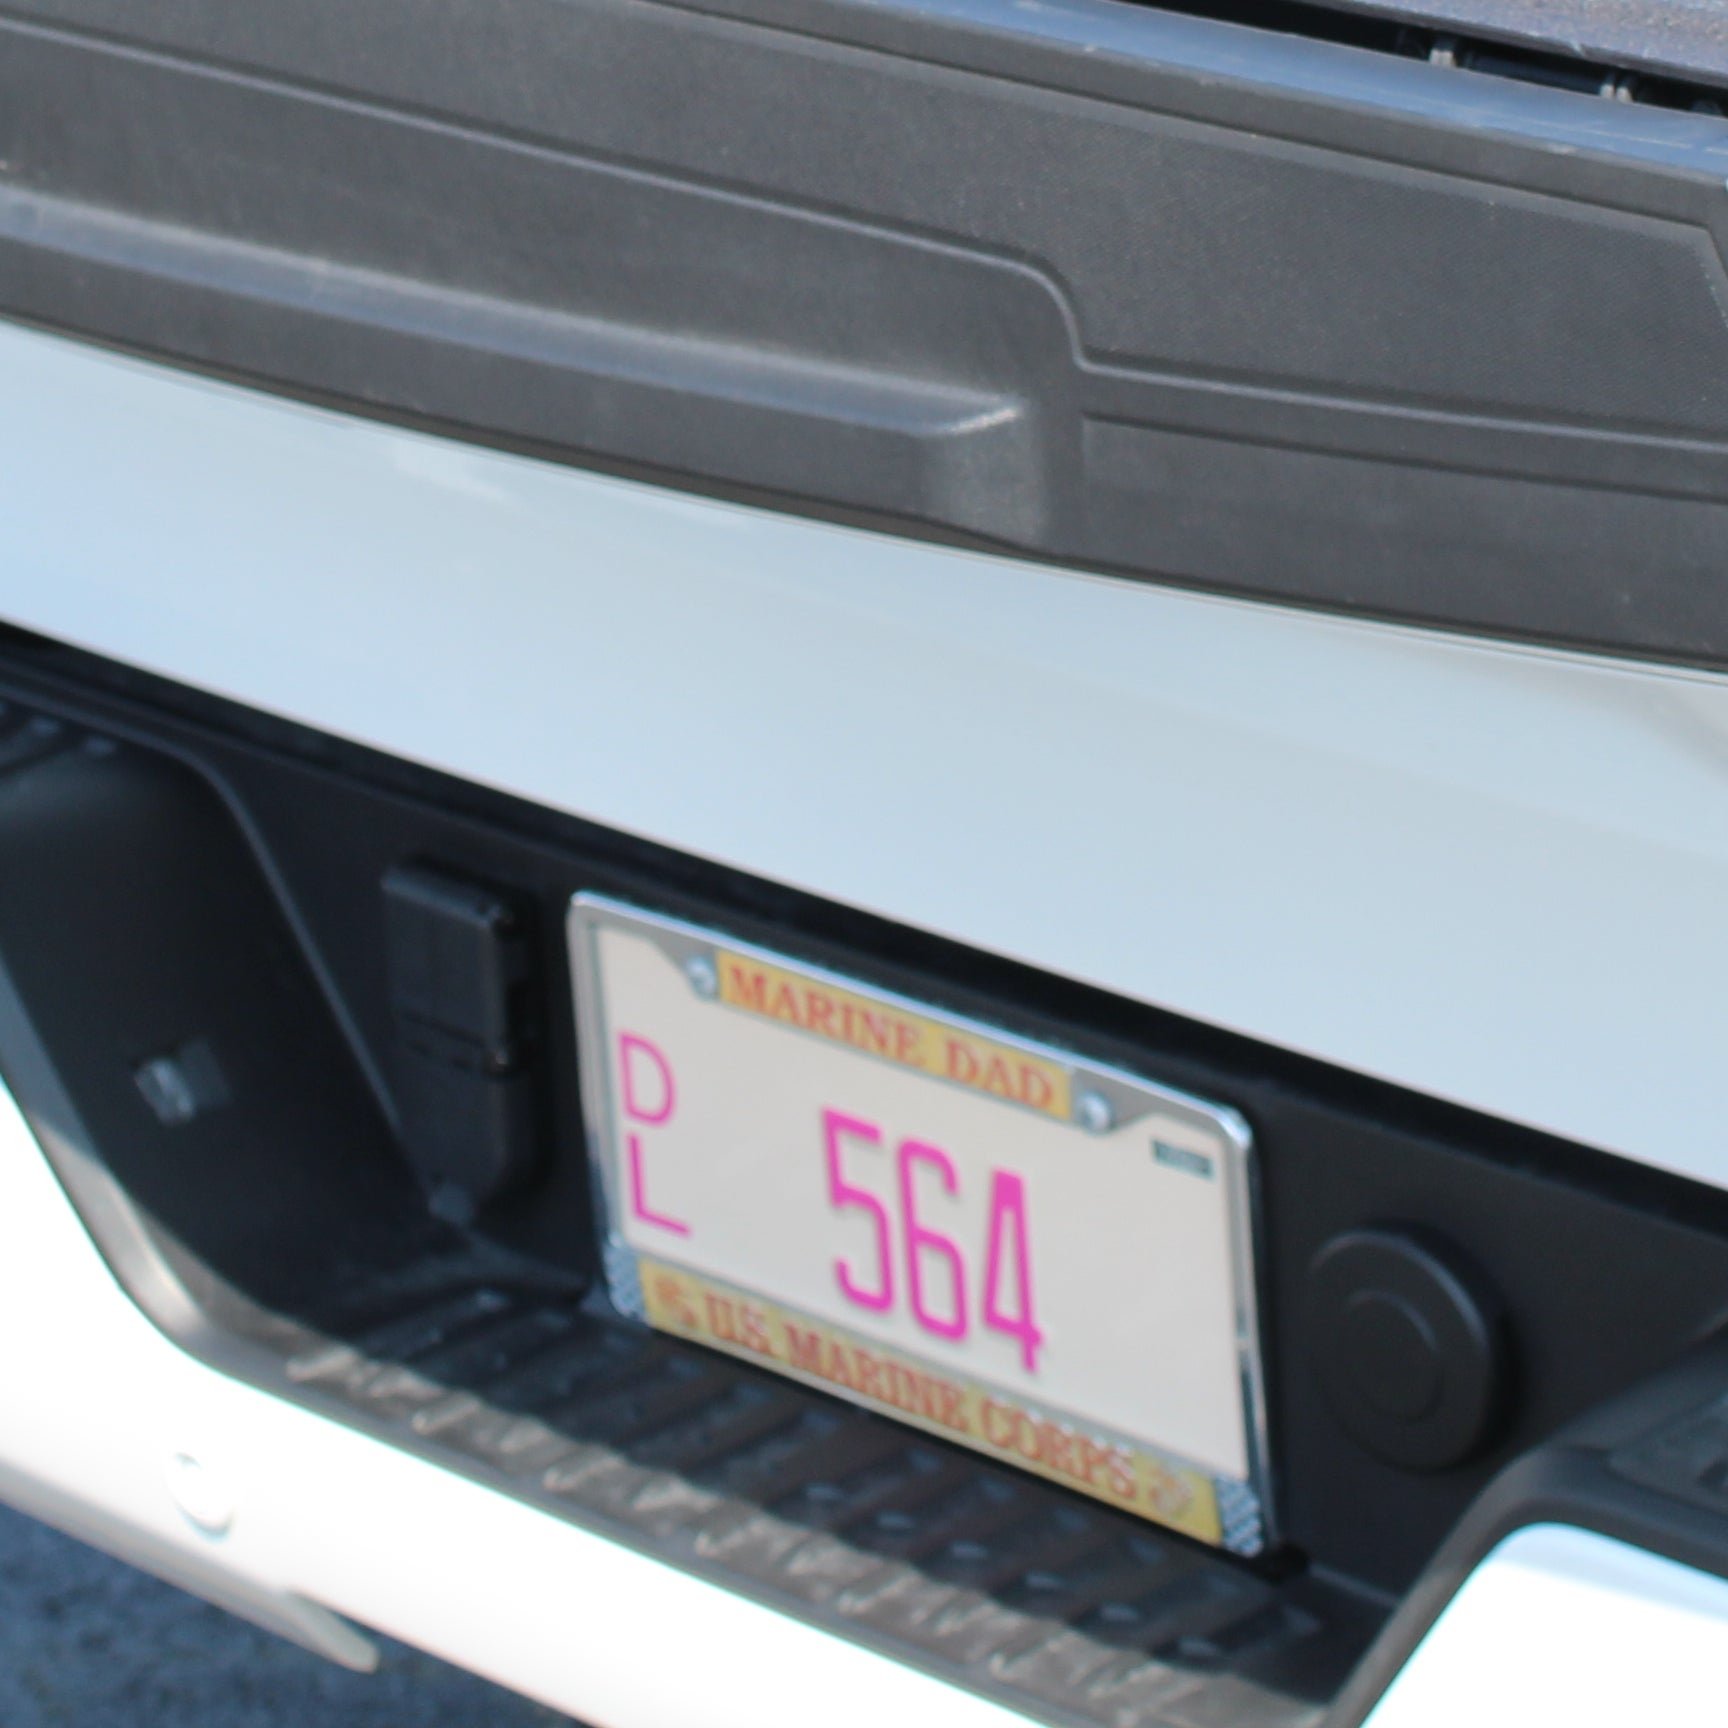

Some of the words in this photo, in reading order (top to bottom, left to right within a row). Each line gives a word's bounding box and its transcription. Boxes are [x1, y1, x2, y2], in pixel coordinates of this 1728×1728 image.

[727, 963, 927, 1069] MARINE
[943, 1034, 1055, 1110] DAD
[821, 1107, 1044, 1374] 564
[782, 1321, 969, 1435] MARINE
[979, 1394, 1138, 1503] CORPS
